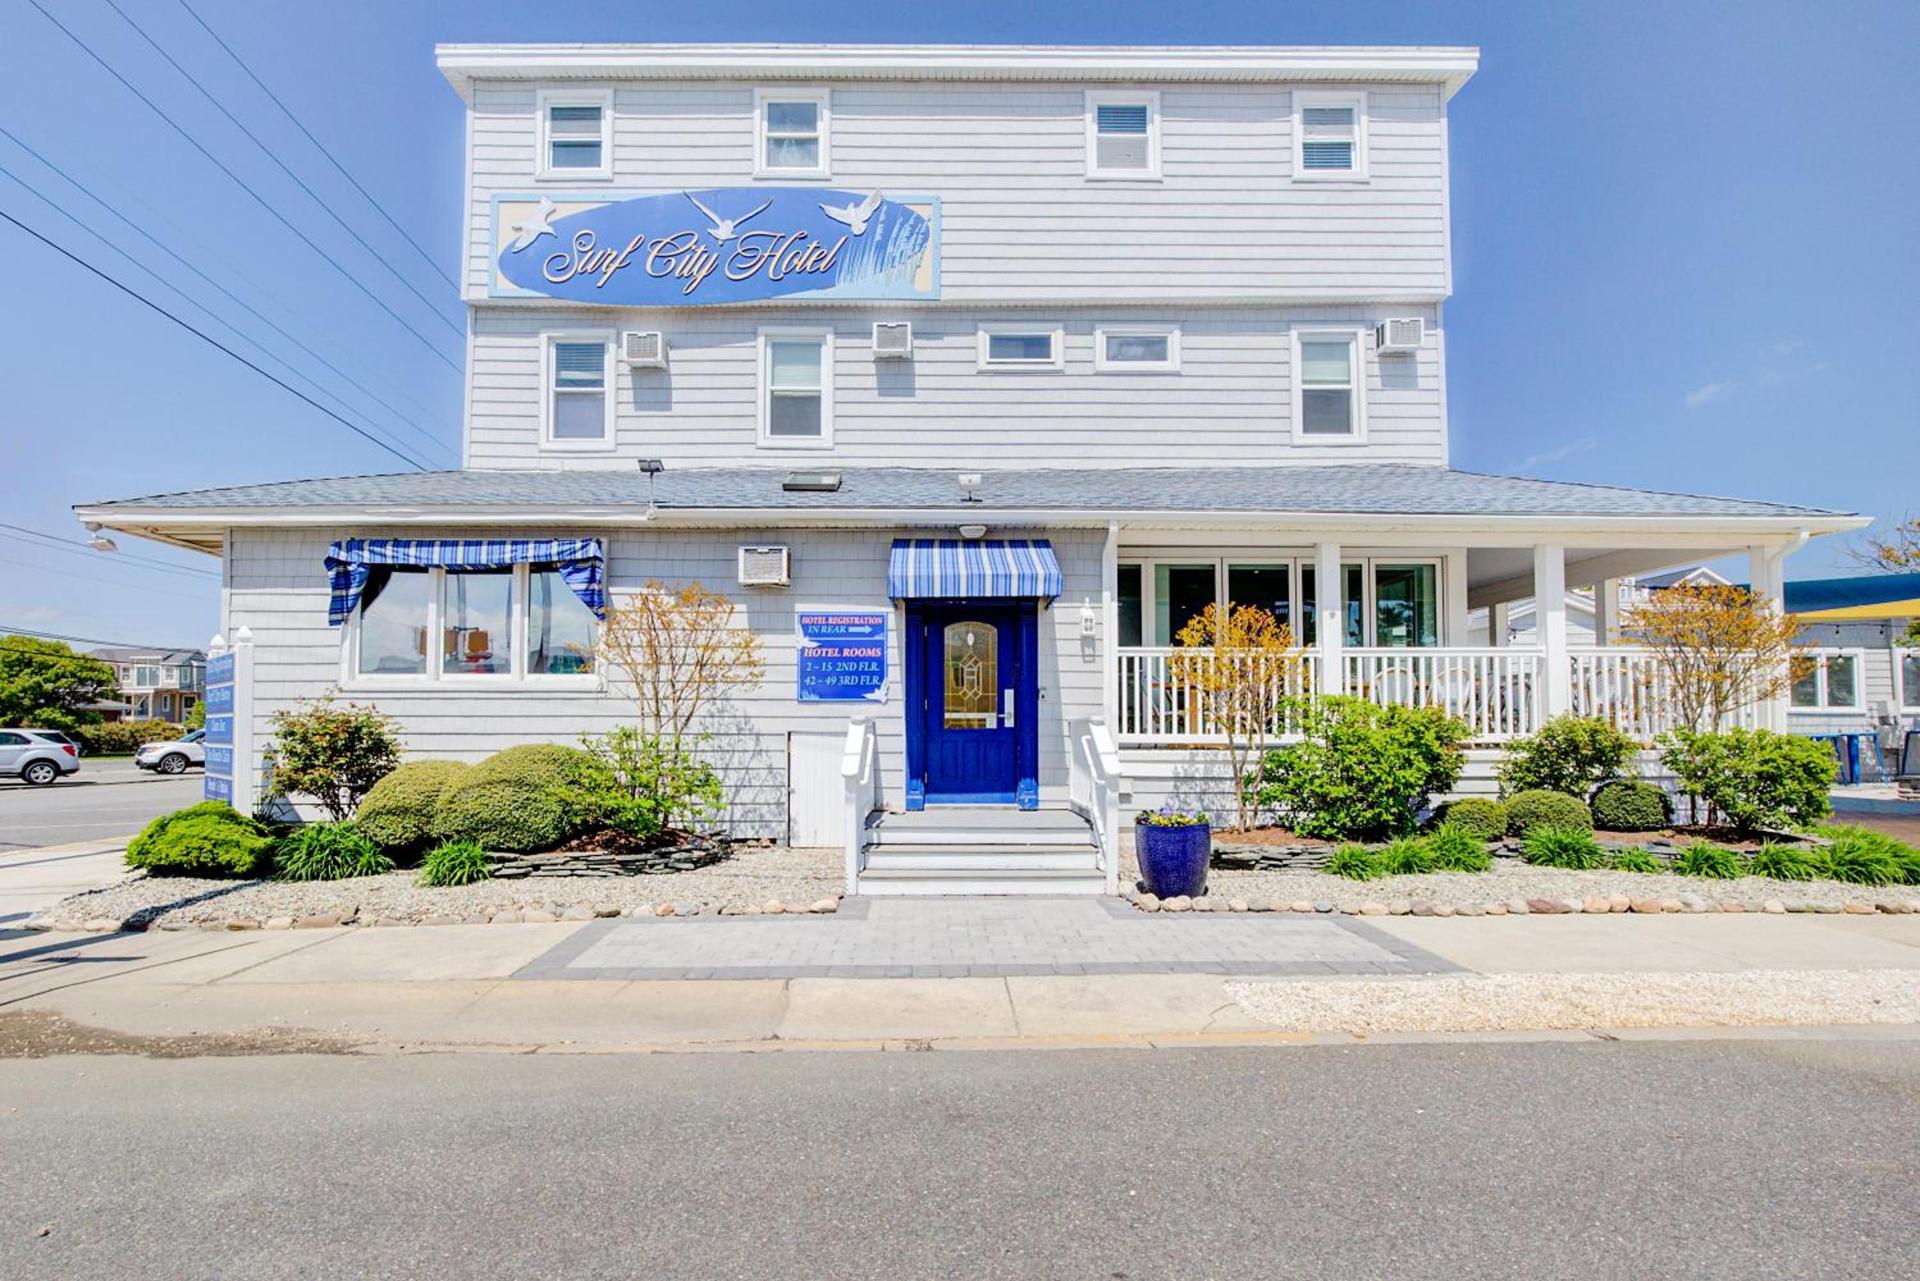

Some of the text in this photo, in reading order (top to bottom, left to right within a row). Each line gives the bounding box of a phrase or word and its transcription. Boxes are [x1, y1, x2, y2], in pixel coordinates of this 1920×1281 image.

[543, 230, 849, 296] Surf City Hotel
[802, 616, 883, 625] HOTEL REGISTRATION
[808, 625, 847, 634] IN REAR
[804, 647, 882, 657] HOTEL ROOMS
[806, 662, 812, 671] 2
[821, 662, 832, 671] 15
[835, 662, 857, 671] 2ND
[804, 676, 817, 686] 42
[825, 676, 837, 686] 49
[838, 676, 859, 686] 3RD
